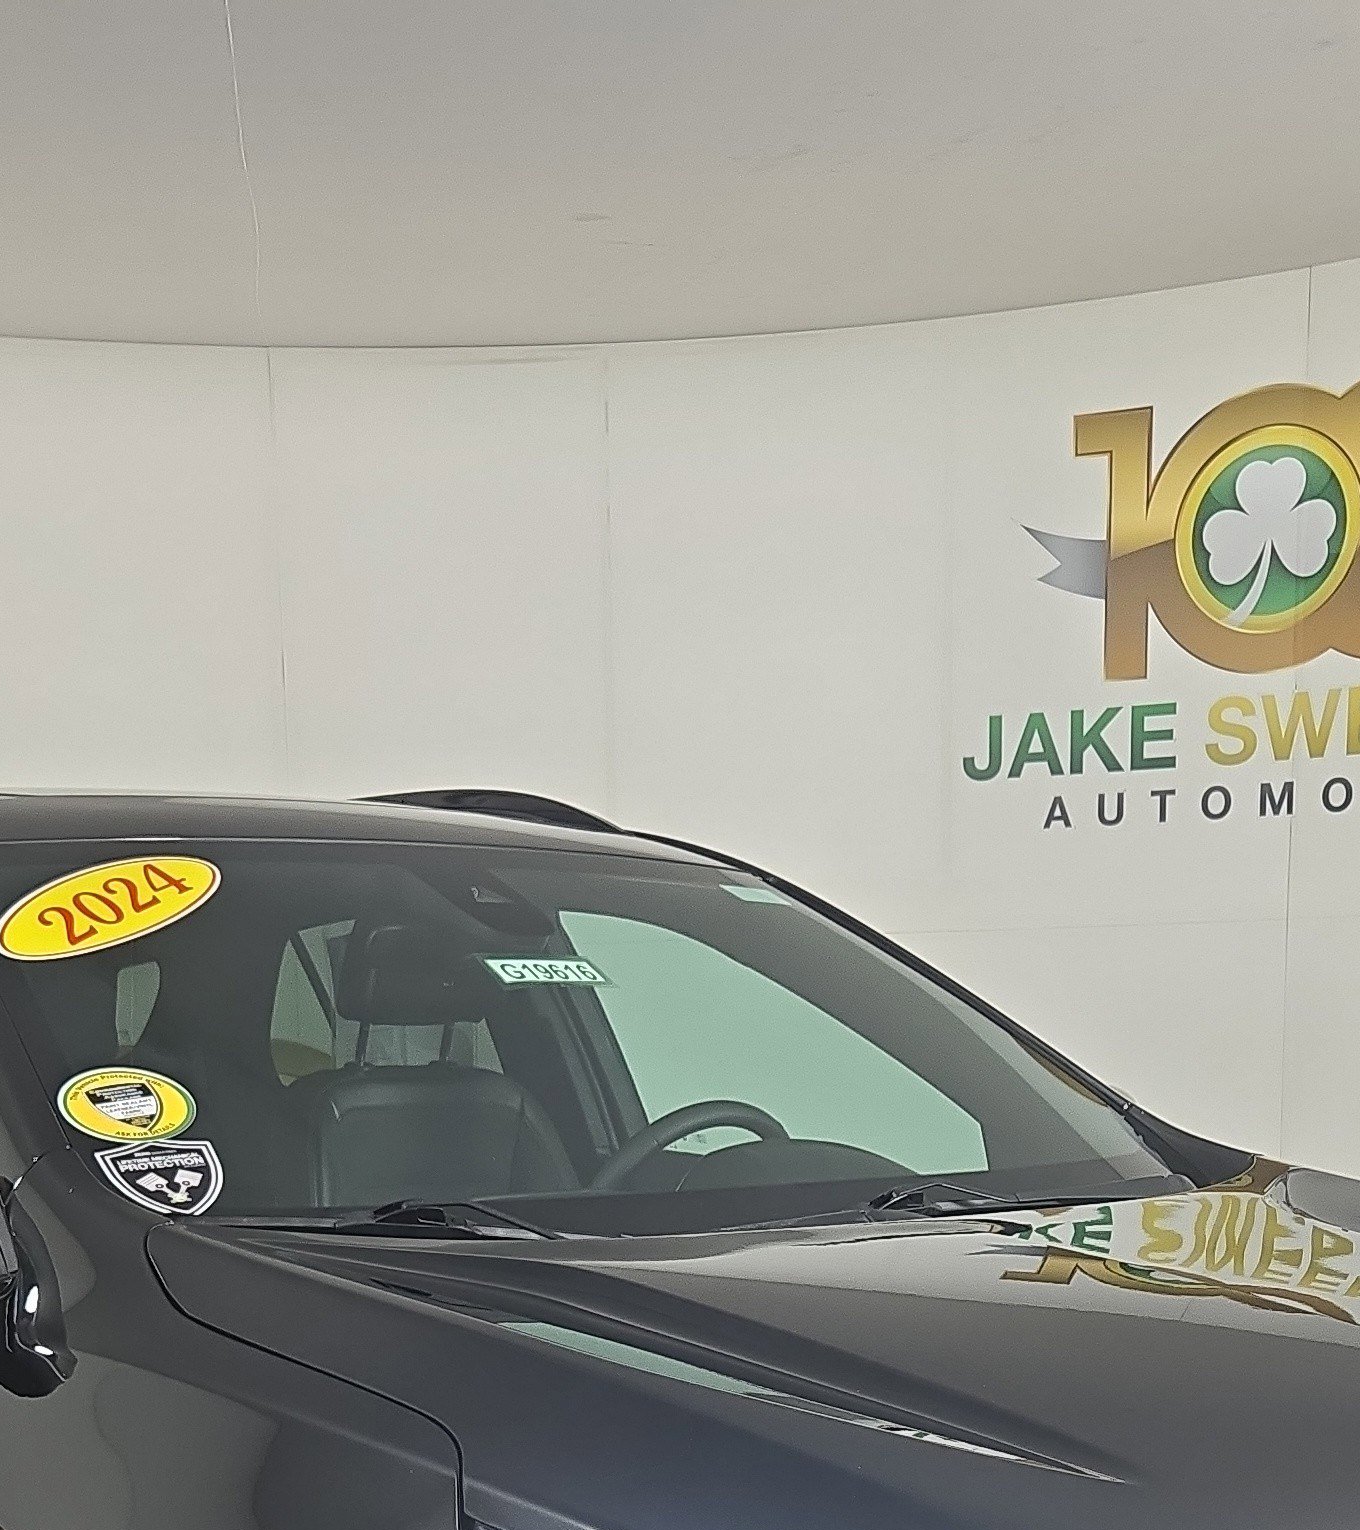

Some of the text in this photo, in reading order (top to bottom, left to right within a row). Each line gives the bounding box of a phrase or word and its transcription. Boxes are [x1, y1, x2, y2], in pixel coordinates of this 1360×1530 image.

[961, 702, 1179, 782] JAKE
[37, 863, 194, 946] 2024
[499, 962, 598, 982] G19616
[99, 1073, 144, 1081] Protected
[118, 1155, 206, 1173] PROTECTION
